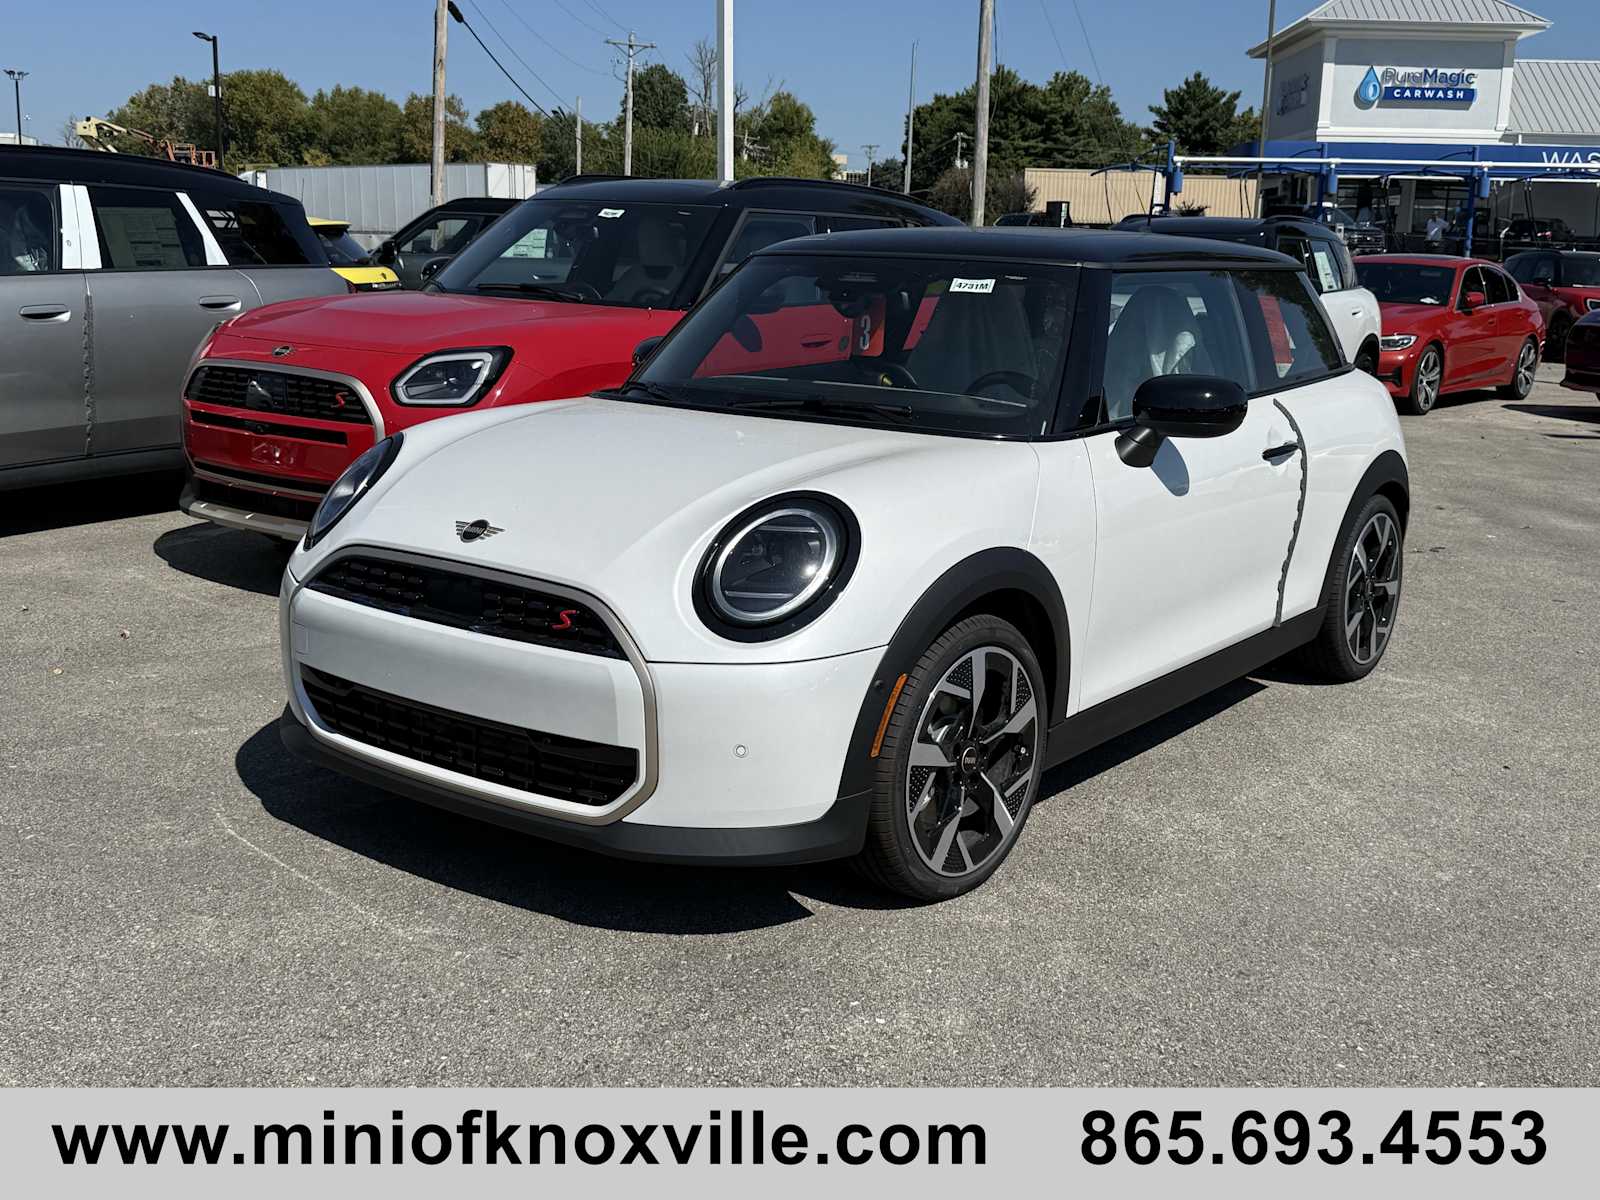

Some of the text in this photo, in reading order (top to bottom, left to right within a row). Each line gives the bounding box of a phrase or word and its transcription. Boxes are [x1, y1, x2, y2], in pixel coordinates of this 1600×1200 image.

[1383, 67, 1475, 87] PureMagic
[1393, 89, 1465, 99] CARWASH
[551, 609, 578, 630] S
